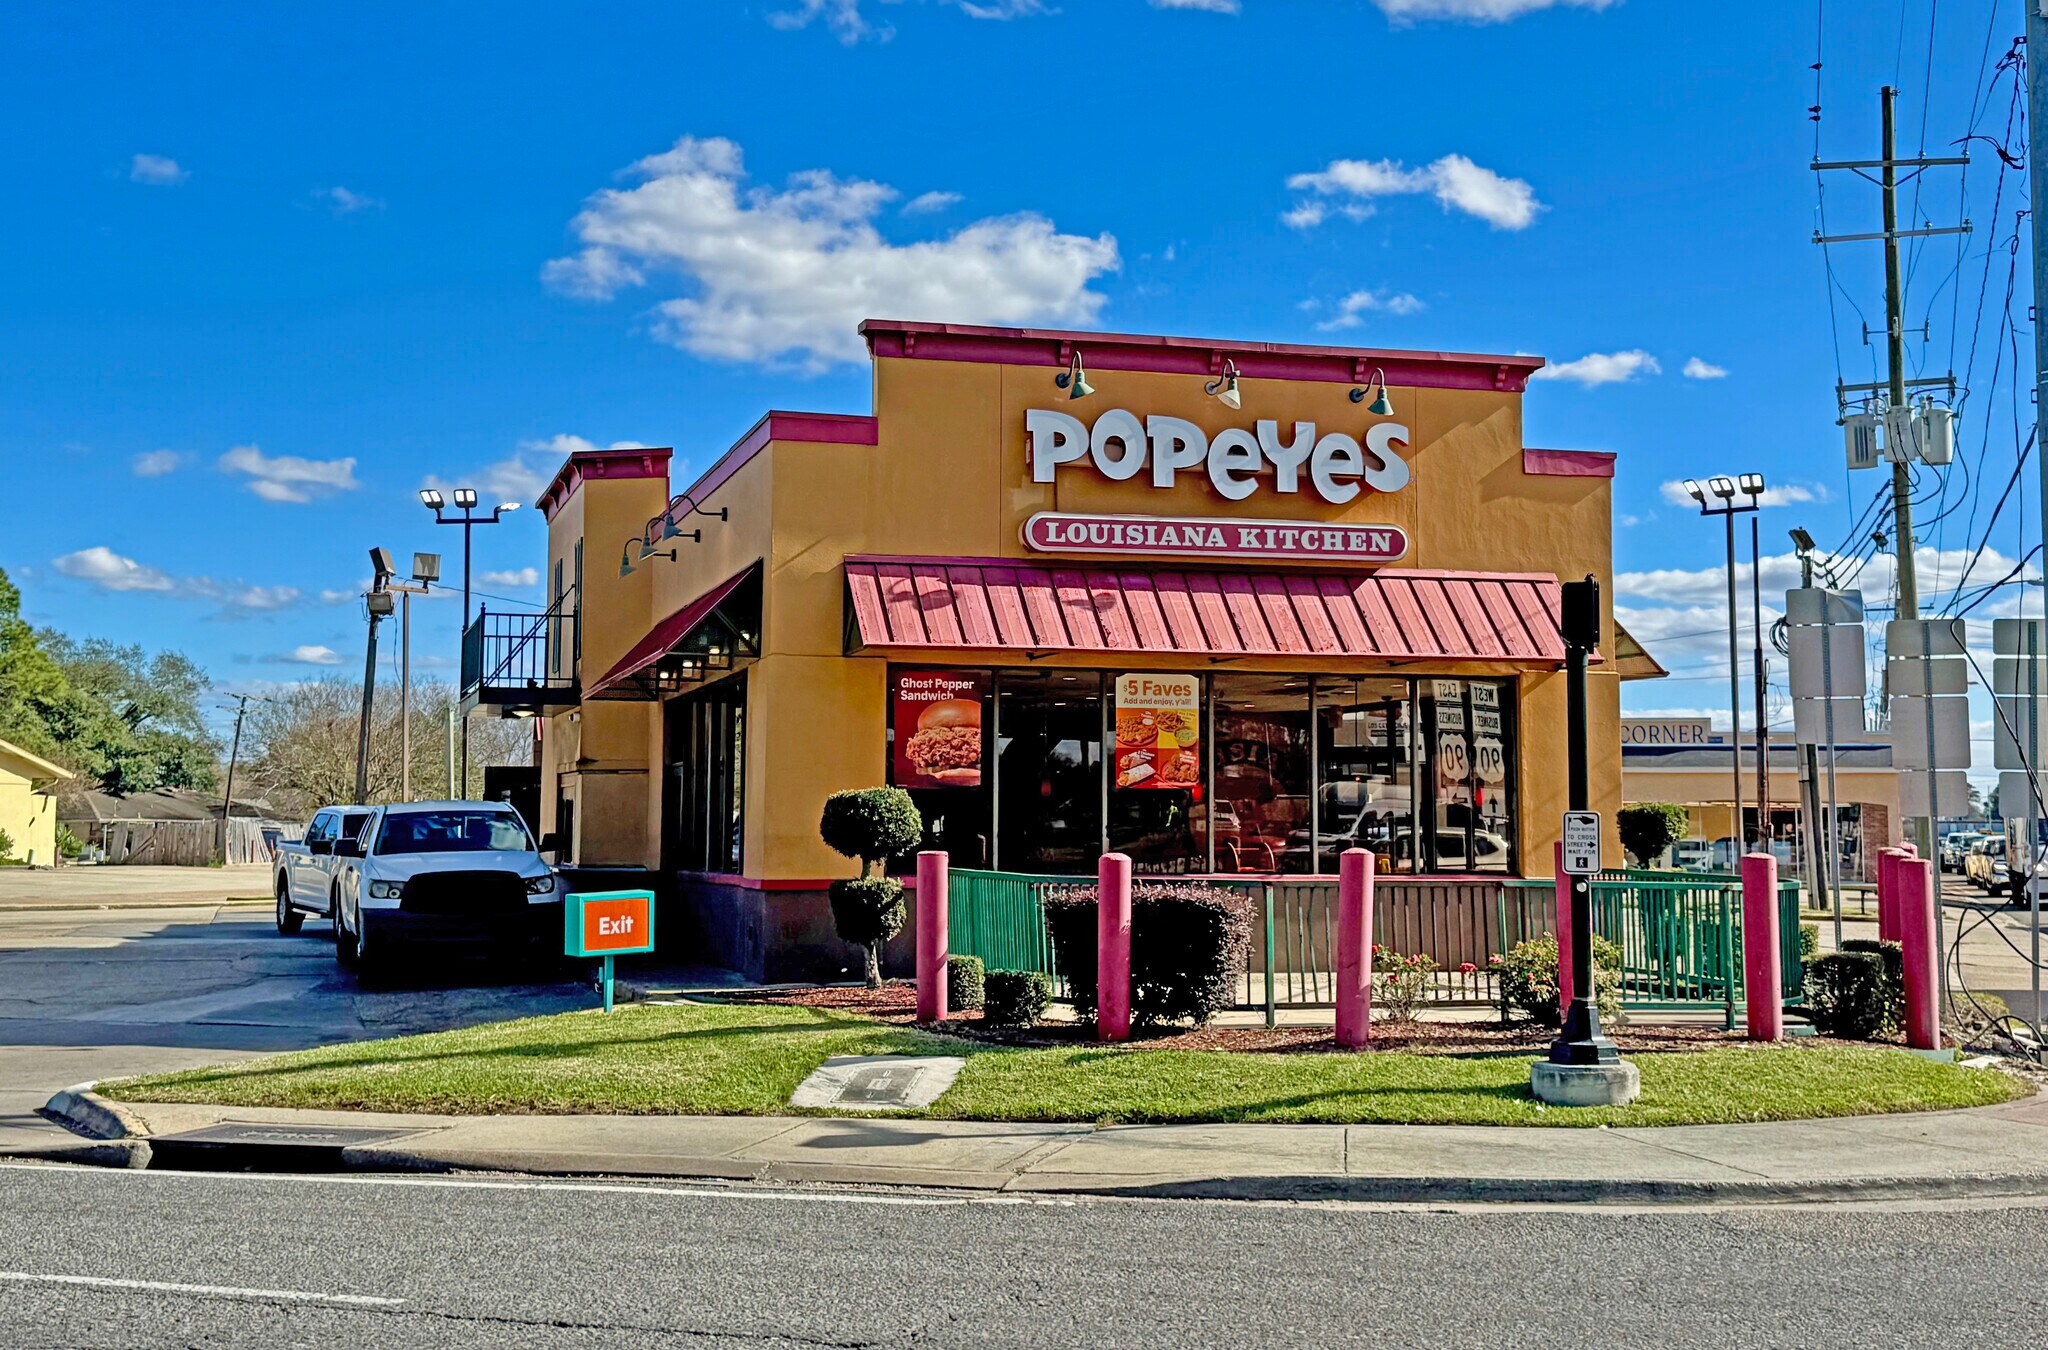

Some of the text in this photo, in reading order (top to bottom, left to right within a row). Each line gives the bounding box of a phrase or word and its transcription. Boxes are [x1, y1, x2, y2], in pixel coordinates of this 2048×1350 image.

[1045, 521, 1392, 553] LOUISIANA KITCHEN
[900, 677, 974, 691] Ghost Pepper
[1123, 680, 1192, 696] $5 Faves
[900, 690, 954, 701] Sandwich
[1123, 697, 1138, 705] Add
[1621, 724, 1704, 744] CORNER
[598, 914, 634, 936] Exit
